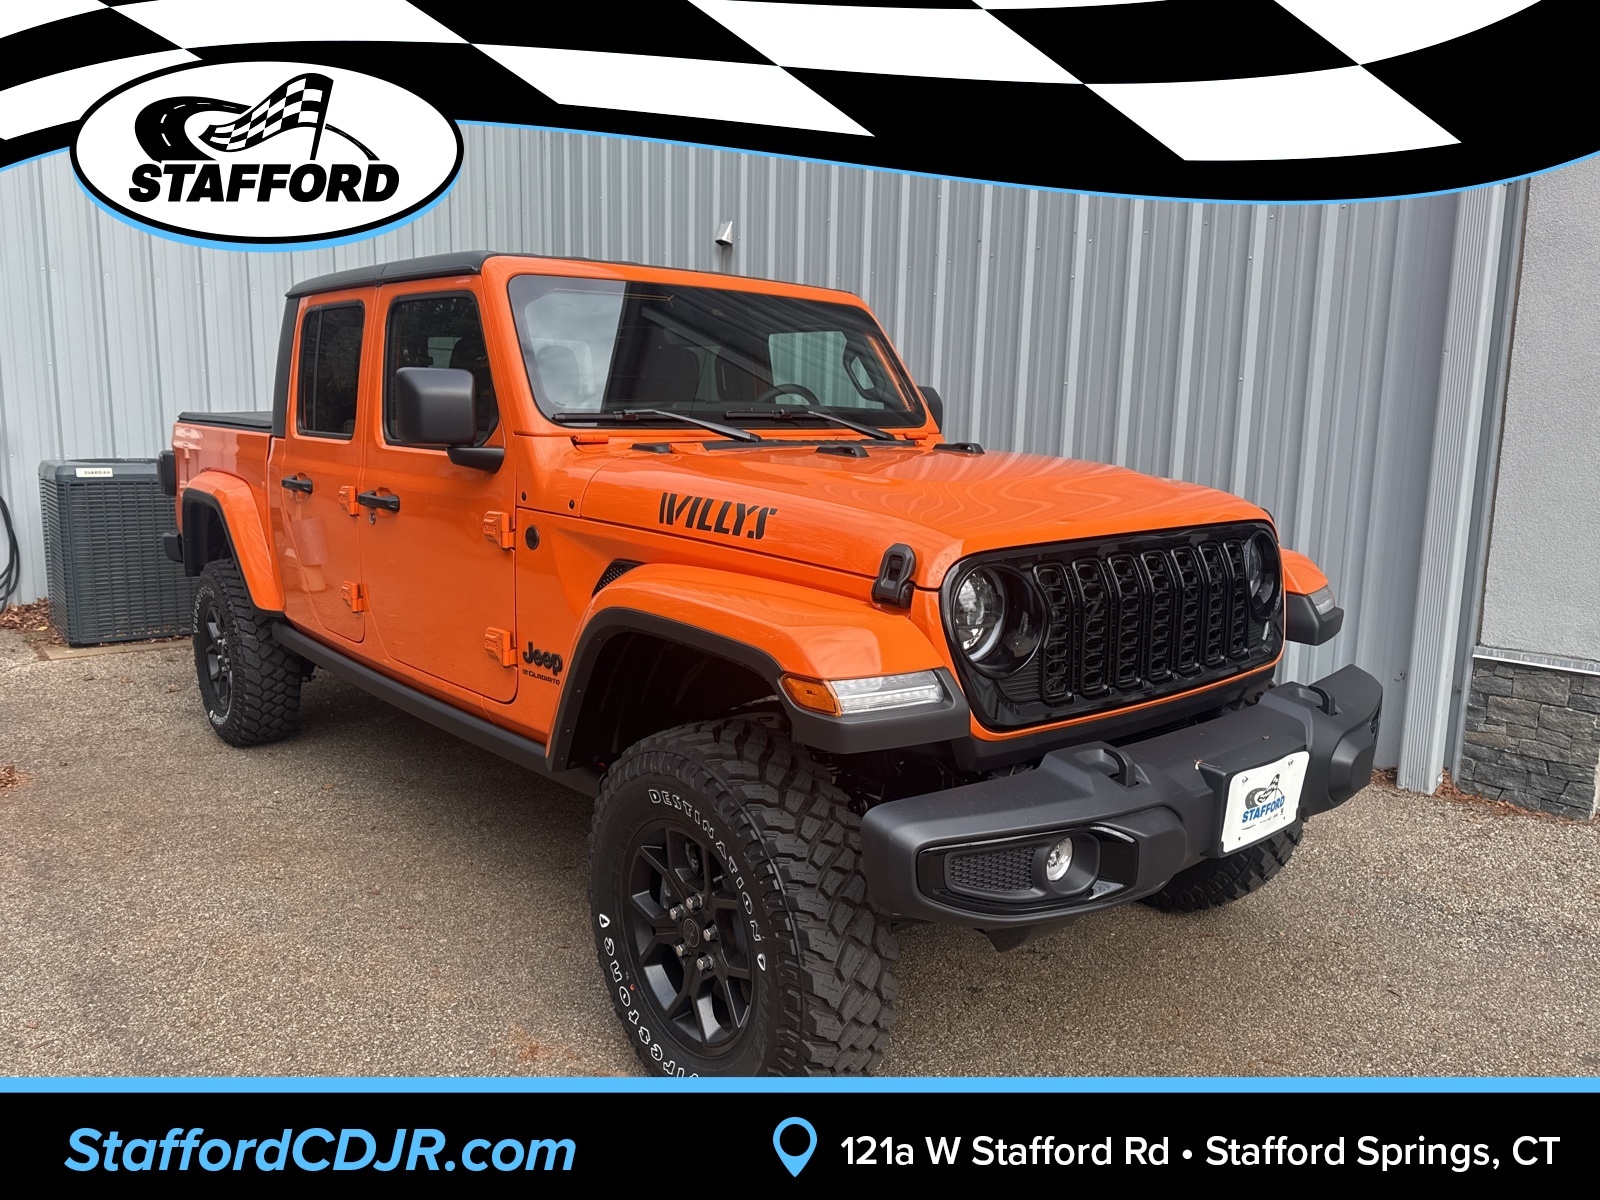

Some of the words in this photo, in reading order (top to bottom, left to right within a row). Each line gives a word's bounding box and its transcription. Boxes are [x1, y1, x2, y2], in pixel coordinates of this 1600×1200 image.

[658, 491, 778, 540] WILLYS
[522, 641, 563, 677] Jeep
[528, 670, 561, 686] GLADIATO
[1241, 795, 1285, 823] STAFFORD
[648, 788, 764, 941] DESTINATION
[603, 936, 699, 1077] irestone
